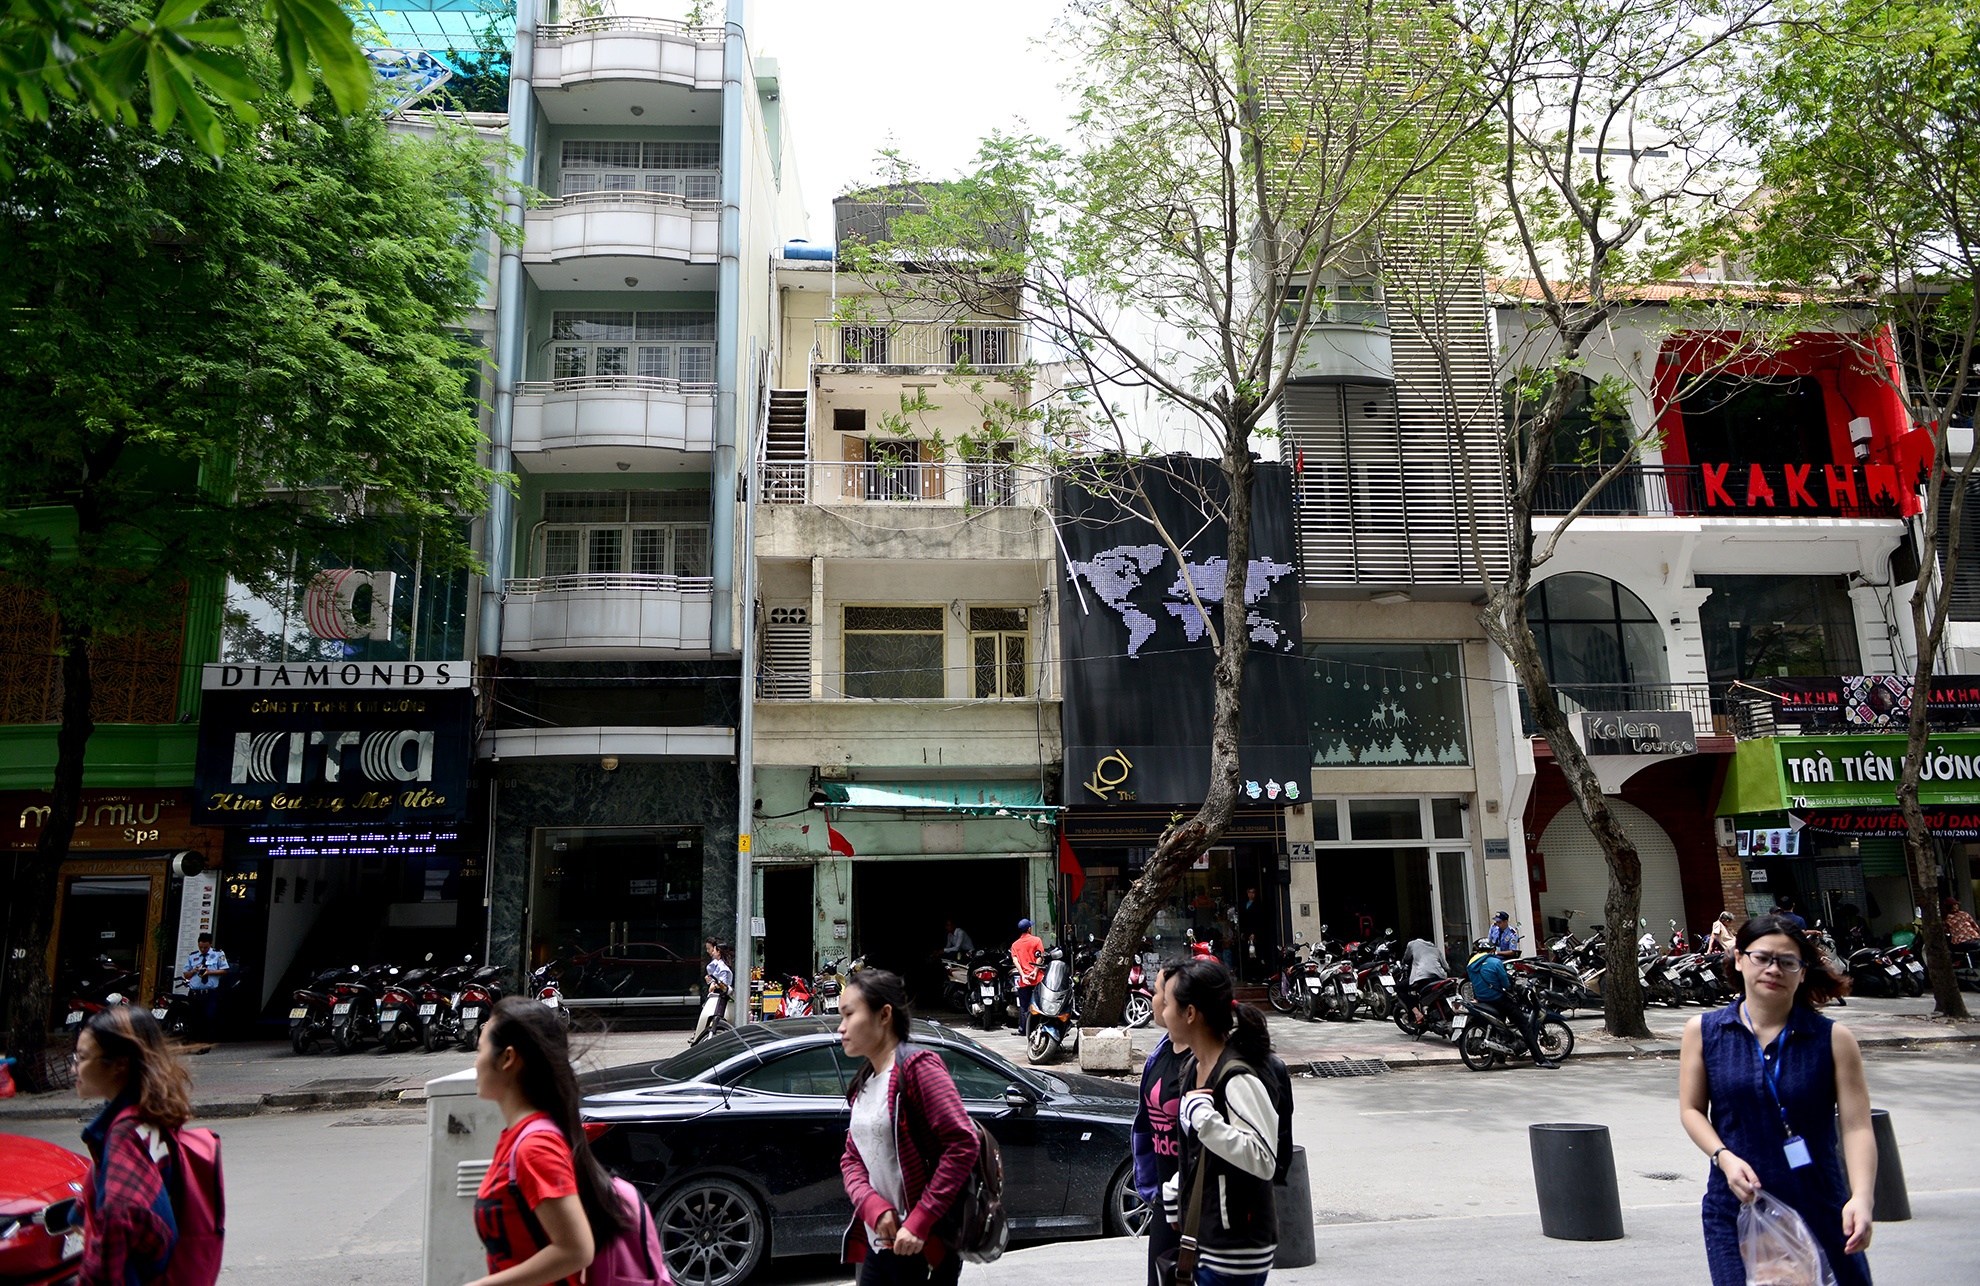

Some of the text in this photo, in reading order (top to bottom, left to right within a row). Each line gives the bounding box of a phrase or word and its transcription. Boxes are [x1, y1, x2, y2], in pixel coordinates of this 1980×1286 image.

[221, 663, 451, 687] DIAMONDS
[251, 699, 287, 713] CÔNG
[1586, 716, 1662, 740] Kalem
[1787, 748, 1835, 783] TRÀ
[1841, 750, 1895, 782] TIÊN
[1083, 749, 1134, 801] KOI
[207, 792, 263, 811] Kim
[1792, 796, 1807, 808] 70
[1830, 813, 1852, 829] TỨ
[1854, 812, 1909, 830] XUYÊN
[1922, 811, 1947, 829] RỨ
[123, 828, 159, 845] Spa
[1292, 844, 1311, 855] 74
[230, 884, 247, 899] 82
[12, 948, 26, 959] 30
